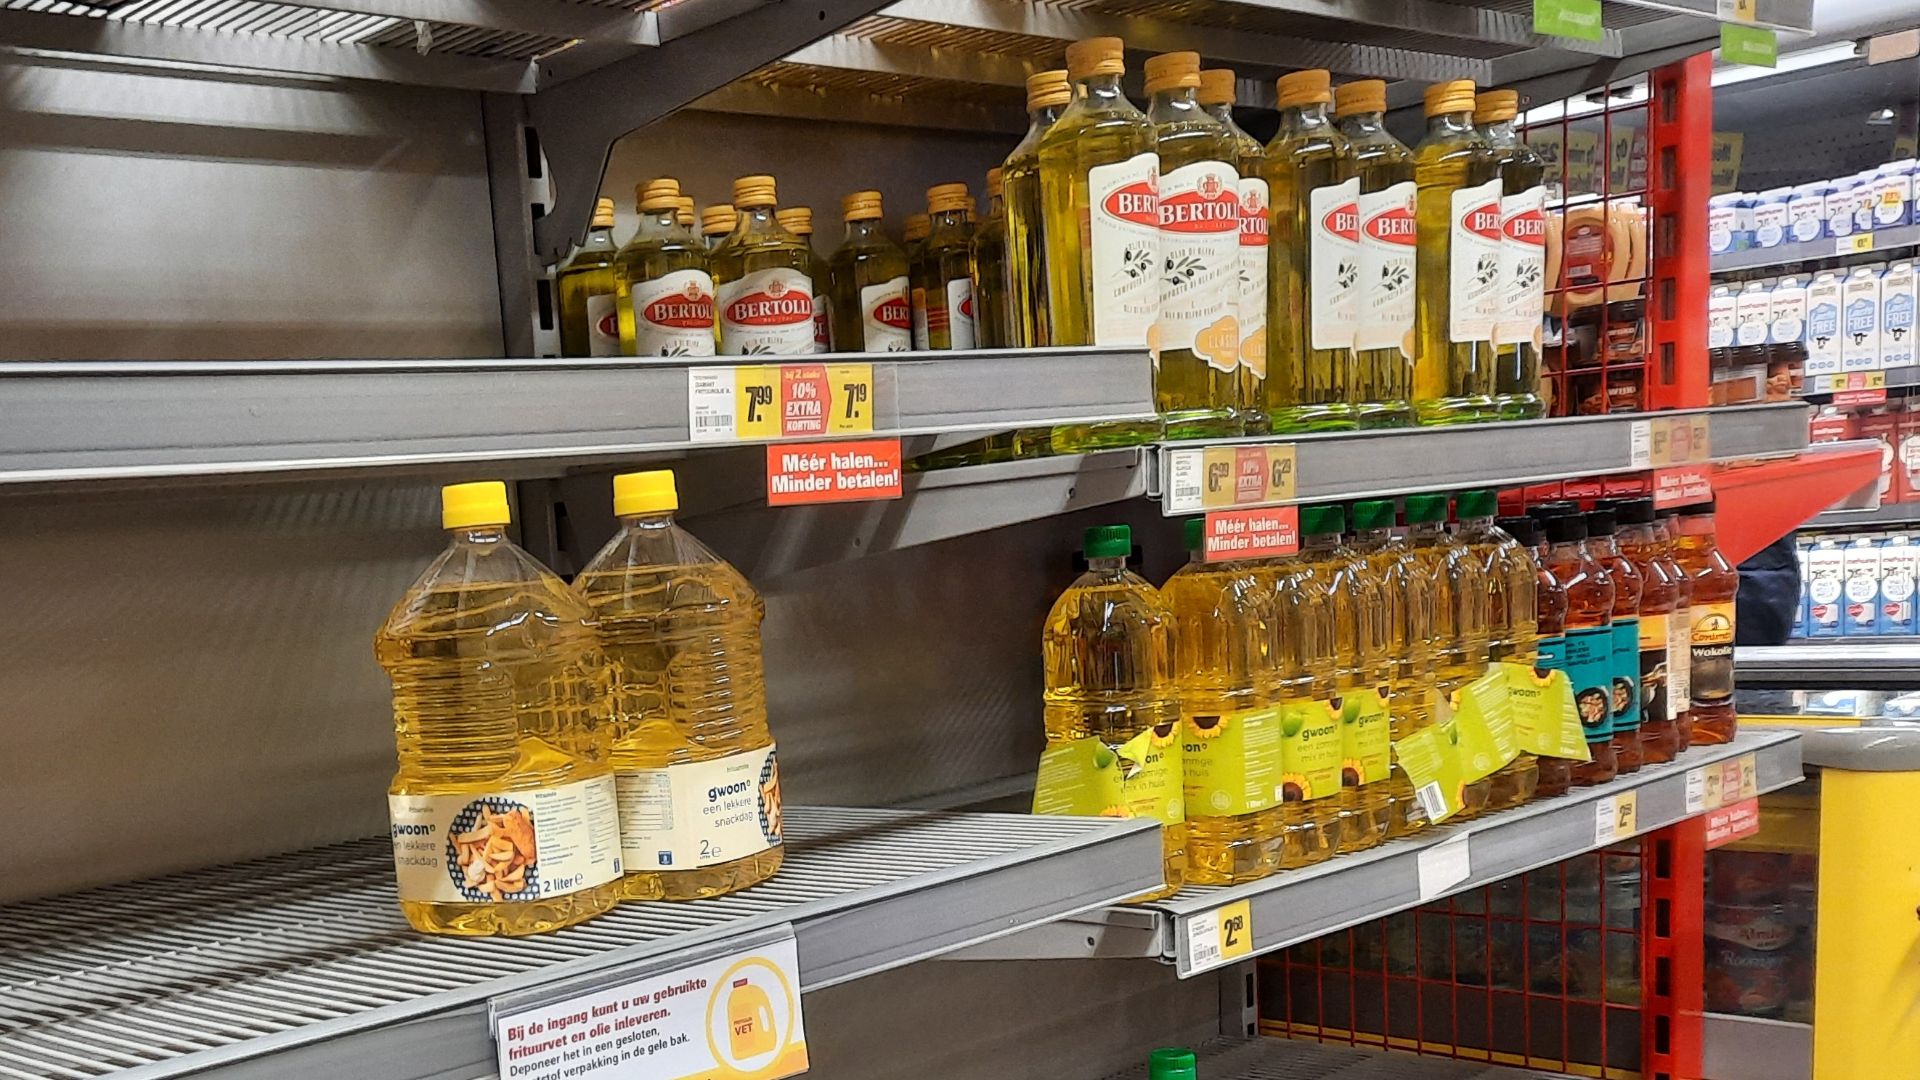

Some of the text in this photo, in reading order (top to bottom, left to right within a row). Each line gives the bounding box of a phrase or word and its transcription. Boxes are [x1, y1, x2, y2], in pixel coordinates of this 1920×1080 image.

[734, 299, 810, 321] BERTOLLI
[791, 382, 817, 399] 10%
[786, 400, 822, 416] EXTRA
[782, 452, 889, 473] Méér halen...
[771, 468, 900, 494] Minder betalen!
[1215, 519, 1246, 535] Méér
[1208, 530, 1296, 552] Minder betalen!
[703, 803, 722, 815] een
[714, 811, 754, 828] snackdag
[700, 839, 709, 856] 2
[543, 880, 551, 893] 2
[554, 877, 573, 891] liter
[507, 978, 707, 1041] Bij de ingang kunt u uw gebruikte
[509, 1008, 671, 1061] frituurvet en olie inleveren.
[734, 1023, 753, 1036] VET
[510, 1027, 660, 1077] Deponeer het in een gesloten,
[563, 1051, 619, 1077] verpakking
[621, 1049, 631, 1060] in
[633, 1043, 645, 1056] de
[648, 1039, 668, 1055] gele
[670, 1033, 691, 1047] bak.
